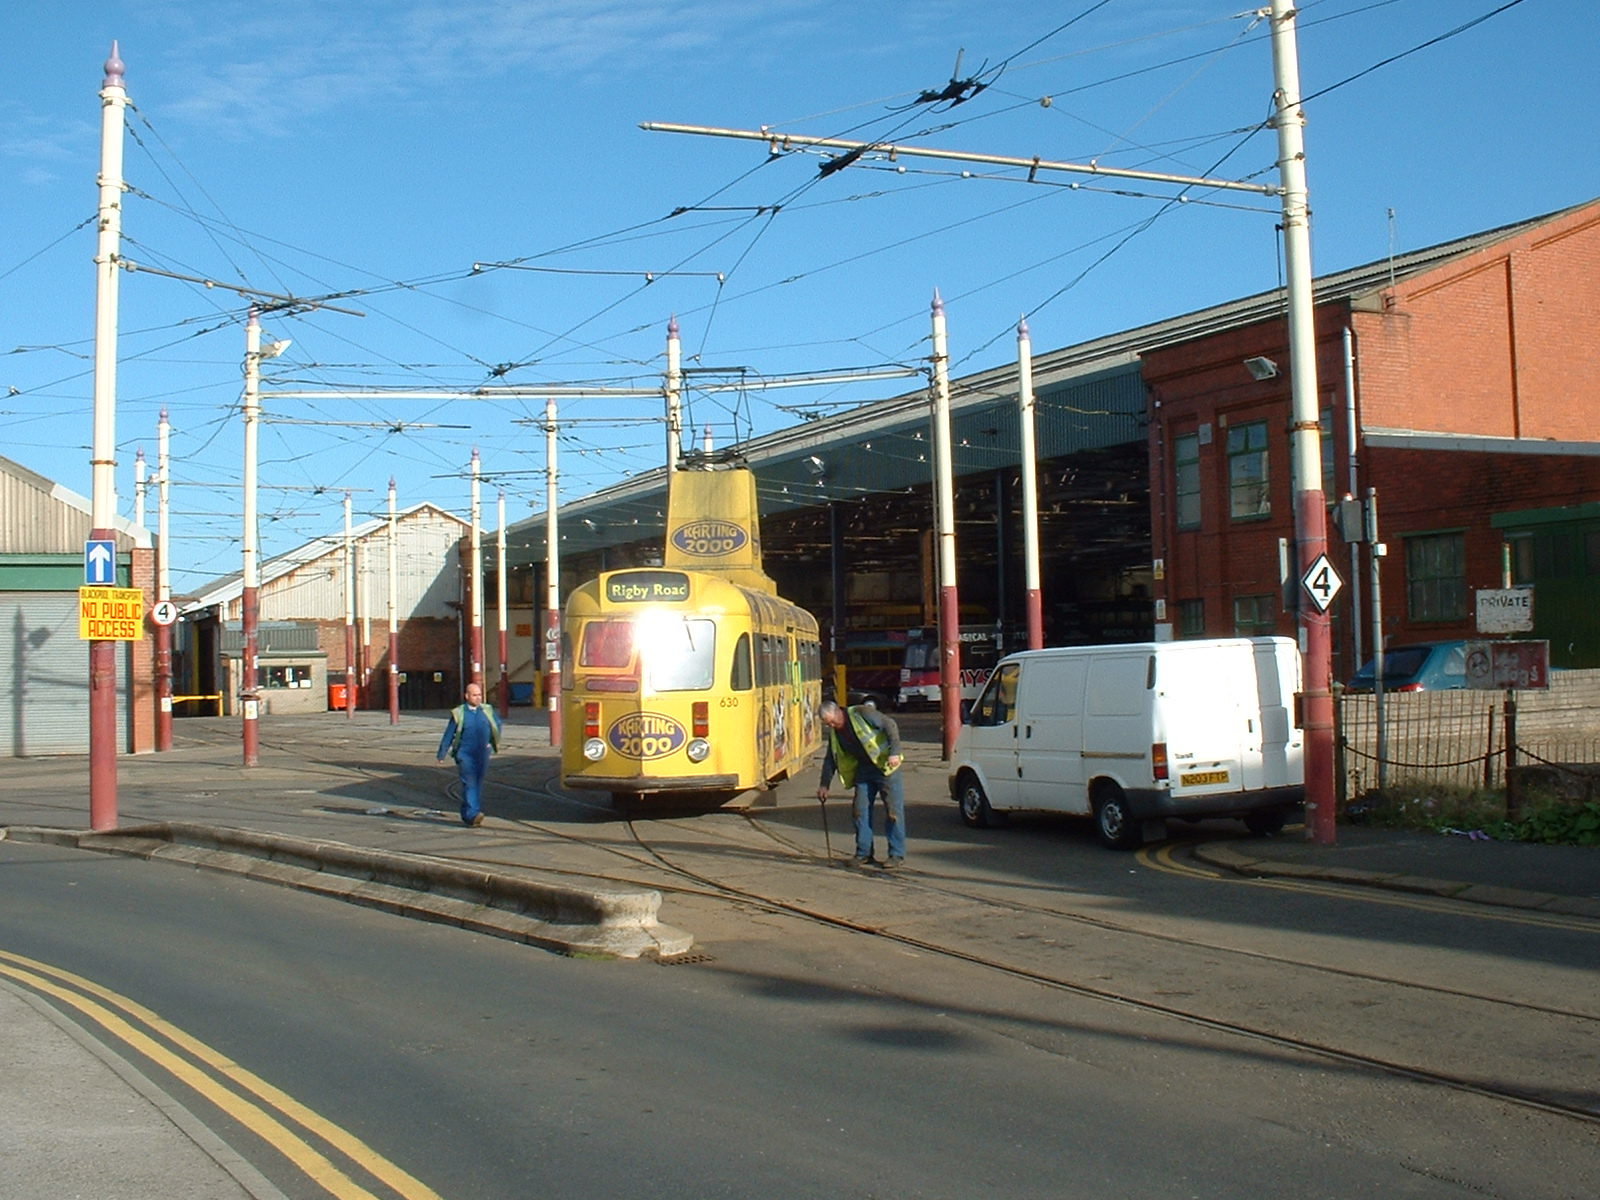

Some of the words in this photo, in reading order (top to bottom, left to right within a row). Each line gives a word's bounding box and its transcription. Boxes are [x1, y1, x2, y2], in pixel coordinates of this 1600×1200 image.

[683, 524, 737, 539] KARTING
[685, 539, 734, 553] 2000
[1313, 567, 1331, 597] 4
[612, 584, 648, 599] Rigby
[1481, 595, 1528, 608] PRIVATE
[82, 602, 97, 618] NO
[103, 602, 141, 619] PUBLIC
[158, 604, 169, 619] 4
[88, 620, 135, 637] ACCESS
[719, 697, 739, 708] 630
[618, 716, 675, 738] KARTING
[620, 737, 672, 755] 2000
